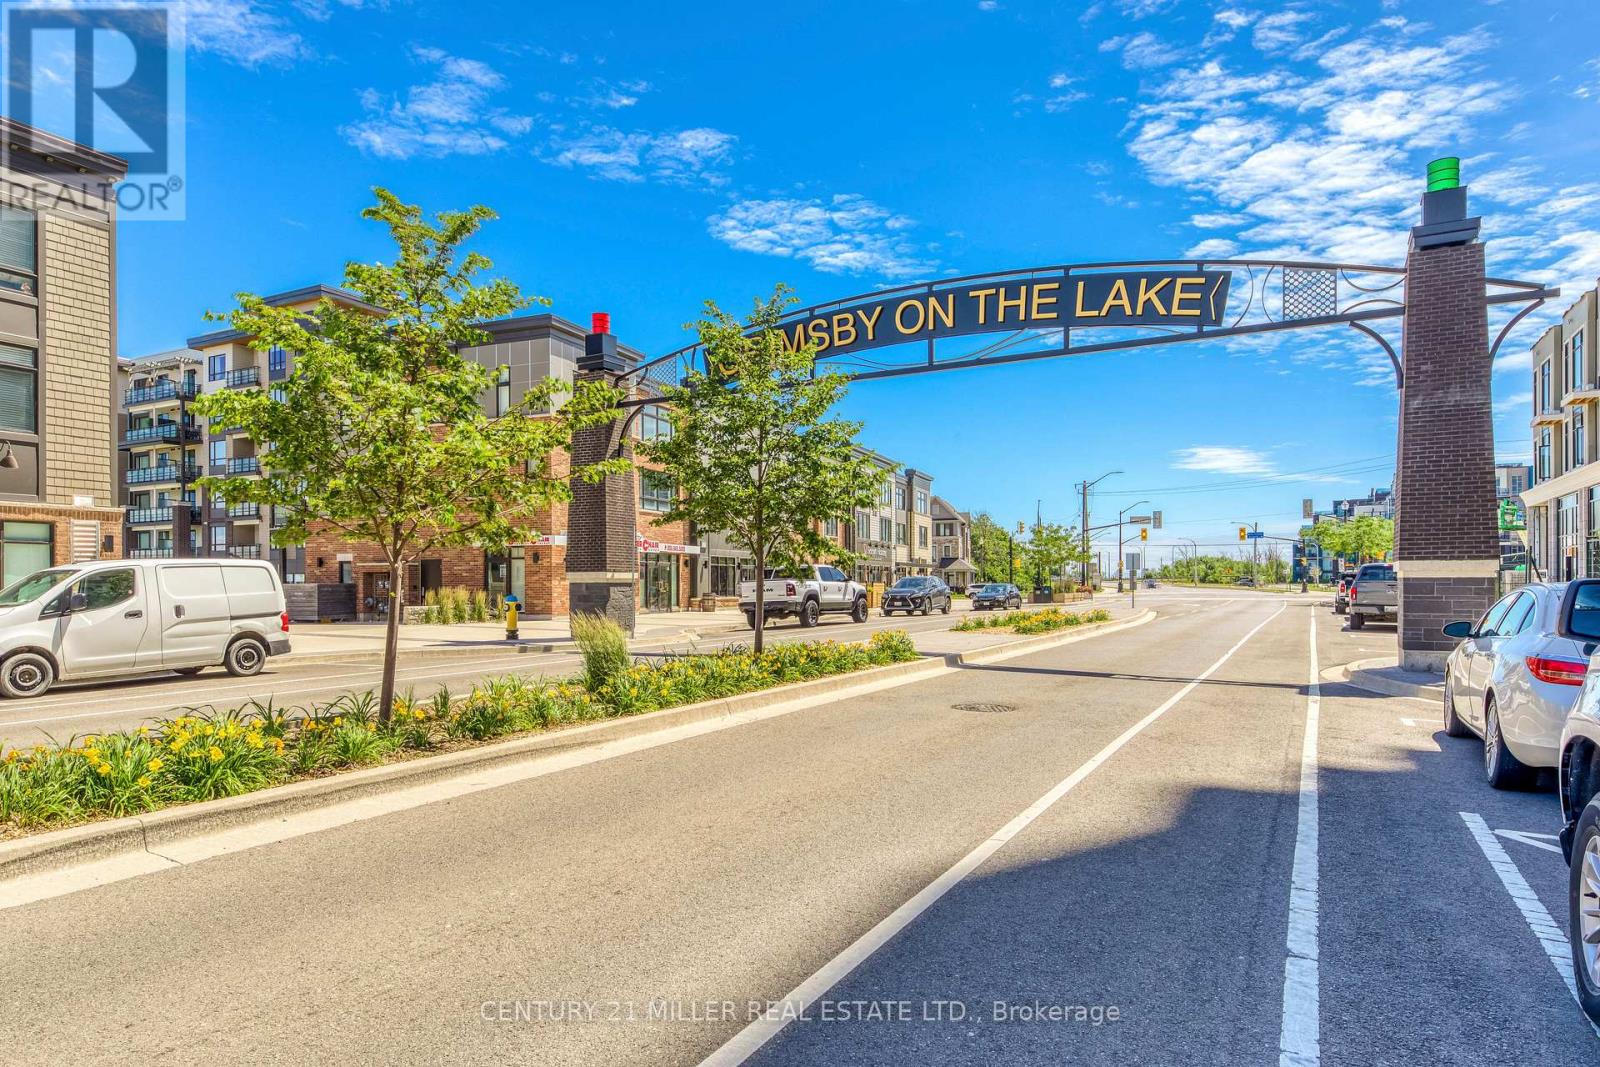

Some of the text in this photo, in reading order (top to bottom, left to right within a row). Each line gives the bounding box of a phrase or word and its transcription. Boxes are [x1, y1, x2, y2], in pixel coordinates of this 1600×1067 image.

[719, 278, 1205, 376] MSBY ON THE LAKE
